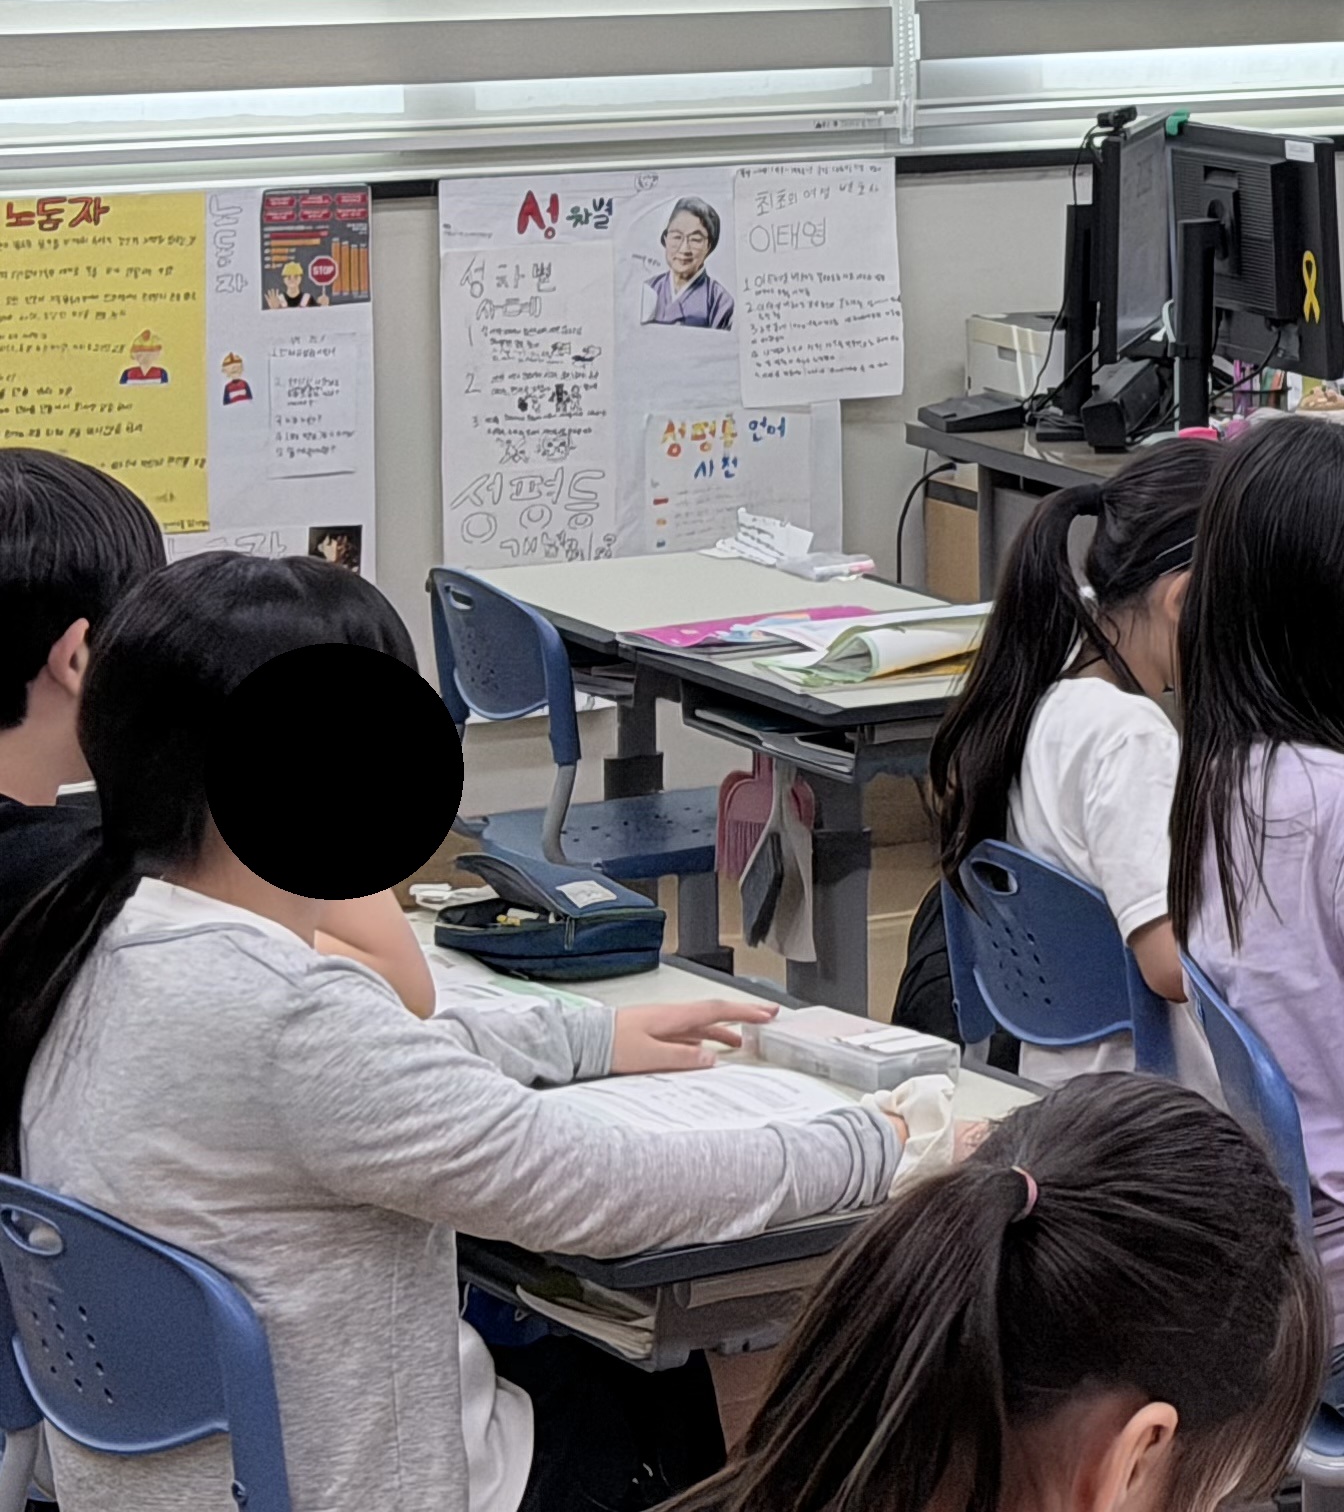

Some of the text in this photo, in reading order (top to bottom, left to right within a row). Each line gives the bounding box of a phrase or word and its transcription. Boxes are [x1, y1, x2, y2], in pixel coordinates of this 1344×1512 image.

[6, 195, 111, 232] 노동자
[749, 216, 827, 254] 이태영
[312, 265, 335, 277] STOP
[748, 415, 786, 442] 언어
[693, 455, 738, 479] 사전
[450, 466, 606, 544] 성평등
